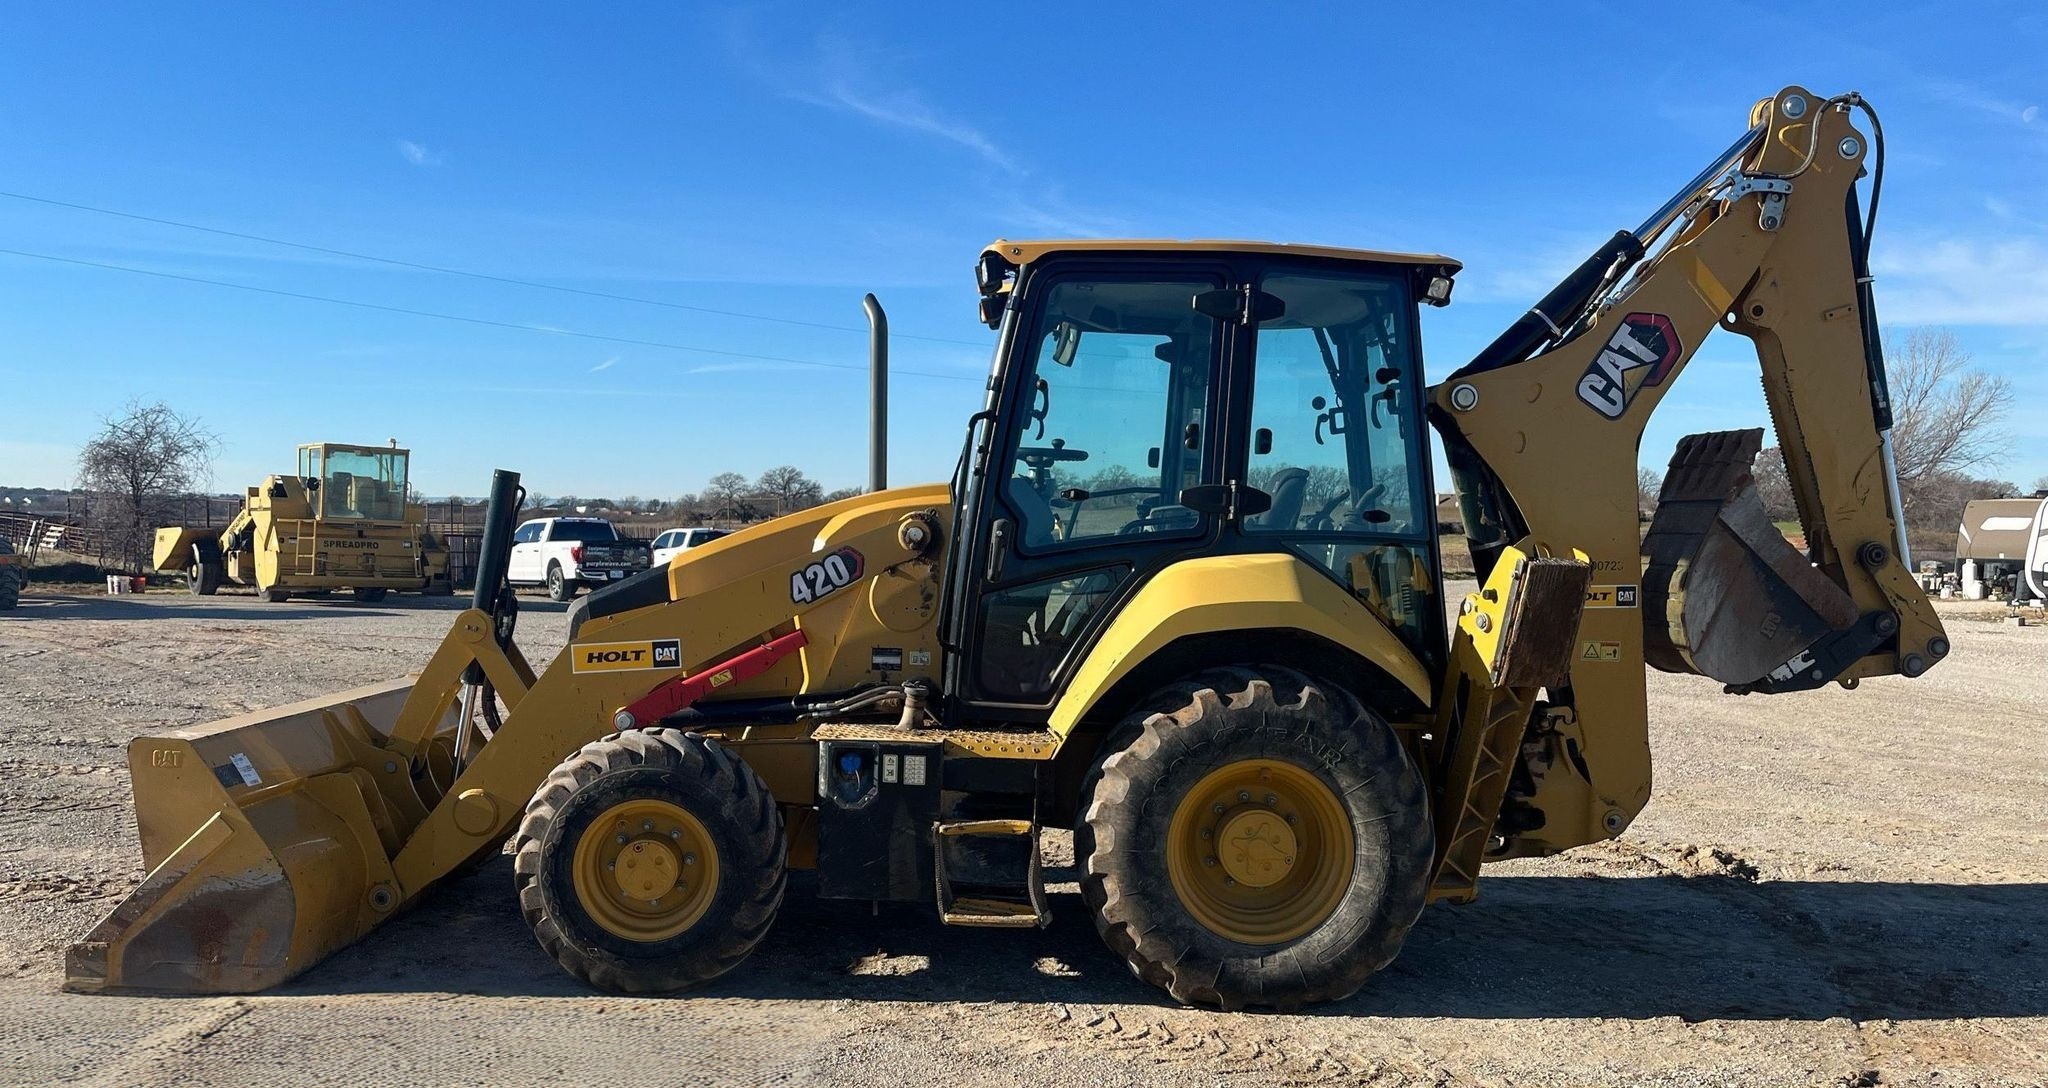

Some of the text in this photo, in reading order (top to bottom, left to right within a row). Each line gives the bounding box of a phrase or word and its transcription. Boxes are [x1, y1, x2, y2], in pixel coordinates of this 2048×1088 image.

[1578, 322, 1660, 417] CAT
[323, 540, 379, 550] SPREADPRO
[586, 560, 632, 568] purplewave.com
[792, 554, 850, 603] 420
[1584, 590, 1635, 602] OLT CAT
[586, 647, 677, 664] HOLT CAT
[152, 749, 181, 768] CAT
